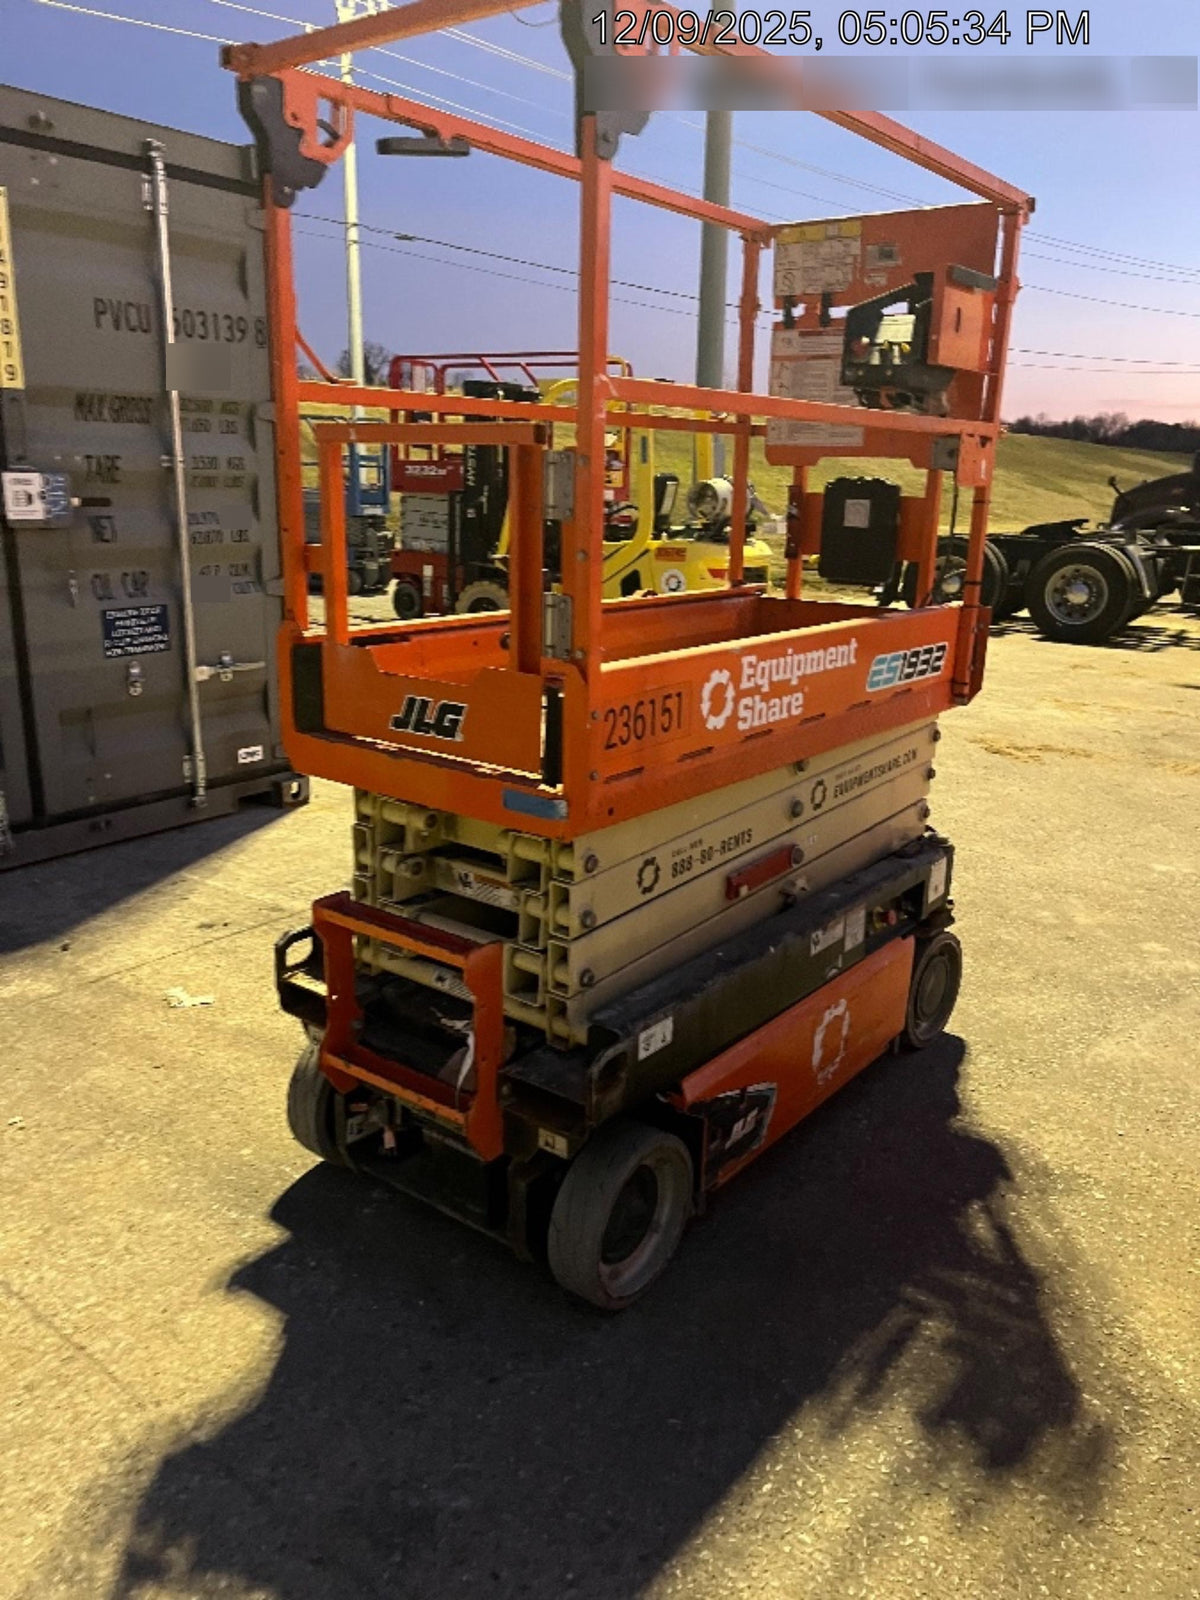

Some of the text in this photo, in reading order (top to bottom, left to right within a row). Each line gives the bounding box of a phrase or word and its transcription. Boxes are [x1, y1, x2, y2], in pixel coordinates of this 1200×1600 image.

[93, 297, 152, 334] PVCU
[740, 638, 858, 693] Equipment
[866, 642, 949, 693] ES1932
[389, 694, 469, 742] JLG
[603, 691, 684, 751] 236151
[737, 692, 804, 731] Share
